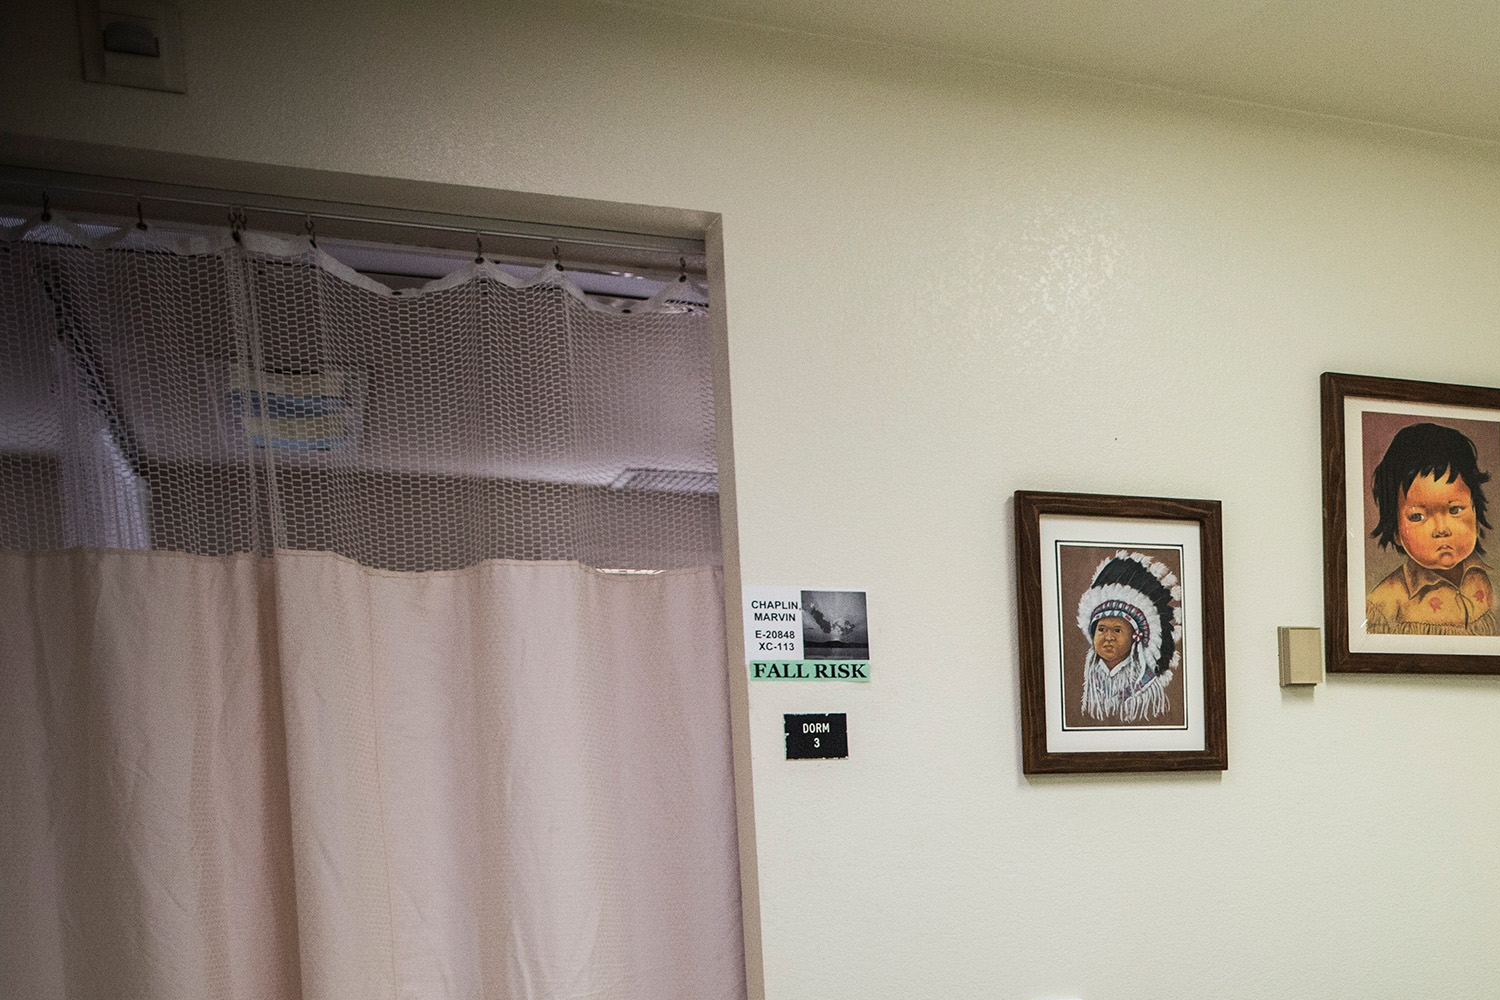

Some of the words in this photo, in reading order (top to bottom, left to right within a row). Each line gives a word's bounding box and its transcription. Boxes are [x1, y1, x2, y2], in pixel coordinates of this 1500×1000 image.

[751, 600, 801, 611] CHAPLIN,
[754, 612, 796, 622] MARVIN
[755, 630, 795, 639] E-20848
[758, 642, 795, 651] XC-113
[753, 663, 809, 679] FALL
[814, 663, 868, 679] RISK
[802, 722, 830, 734] DORM
[813, 738, 820, 748] 3
